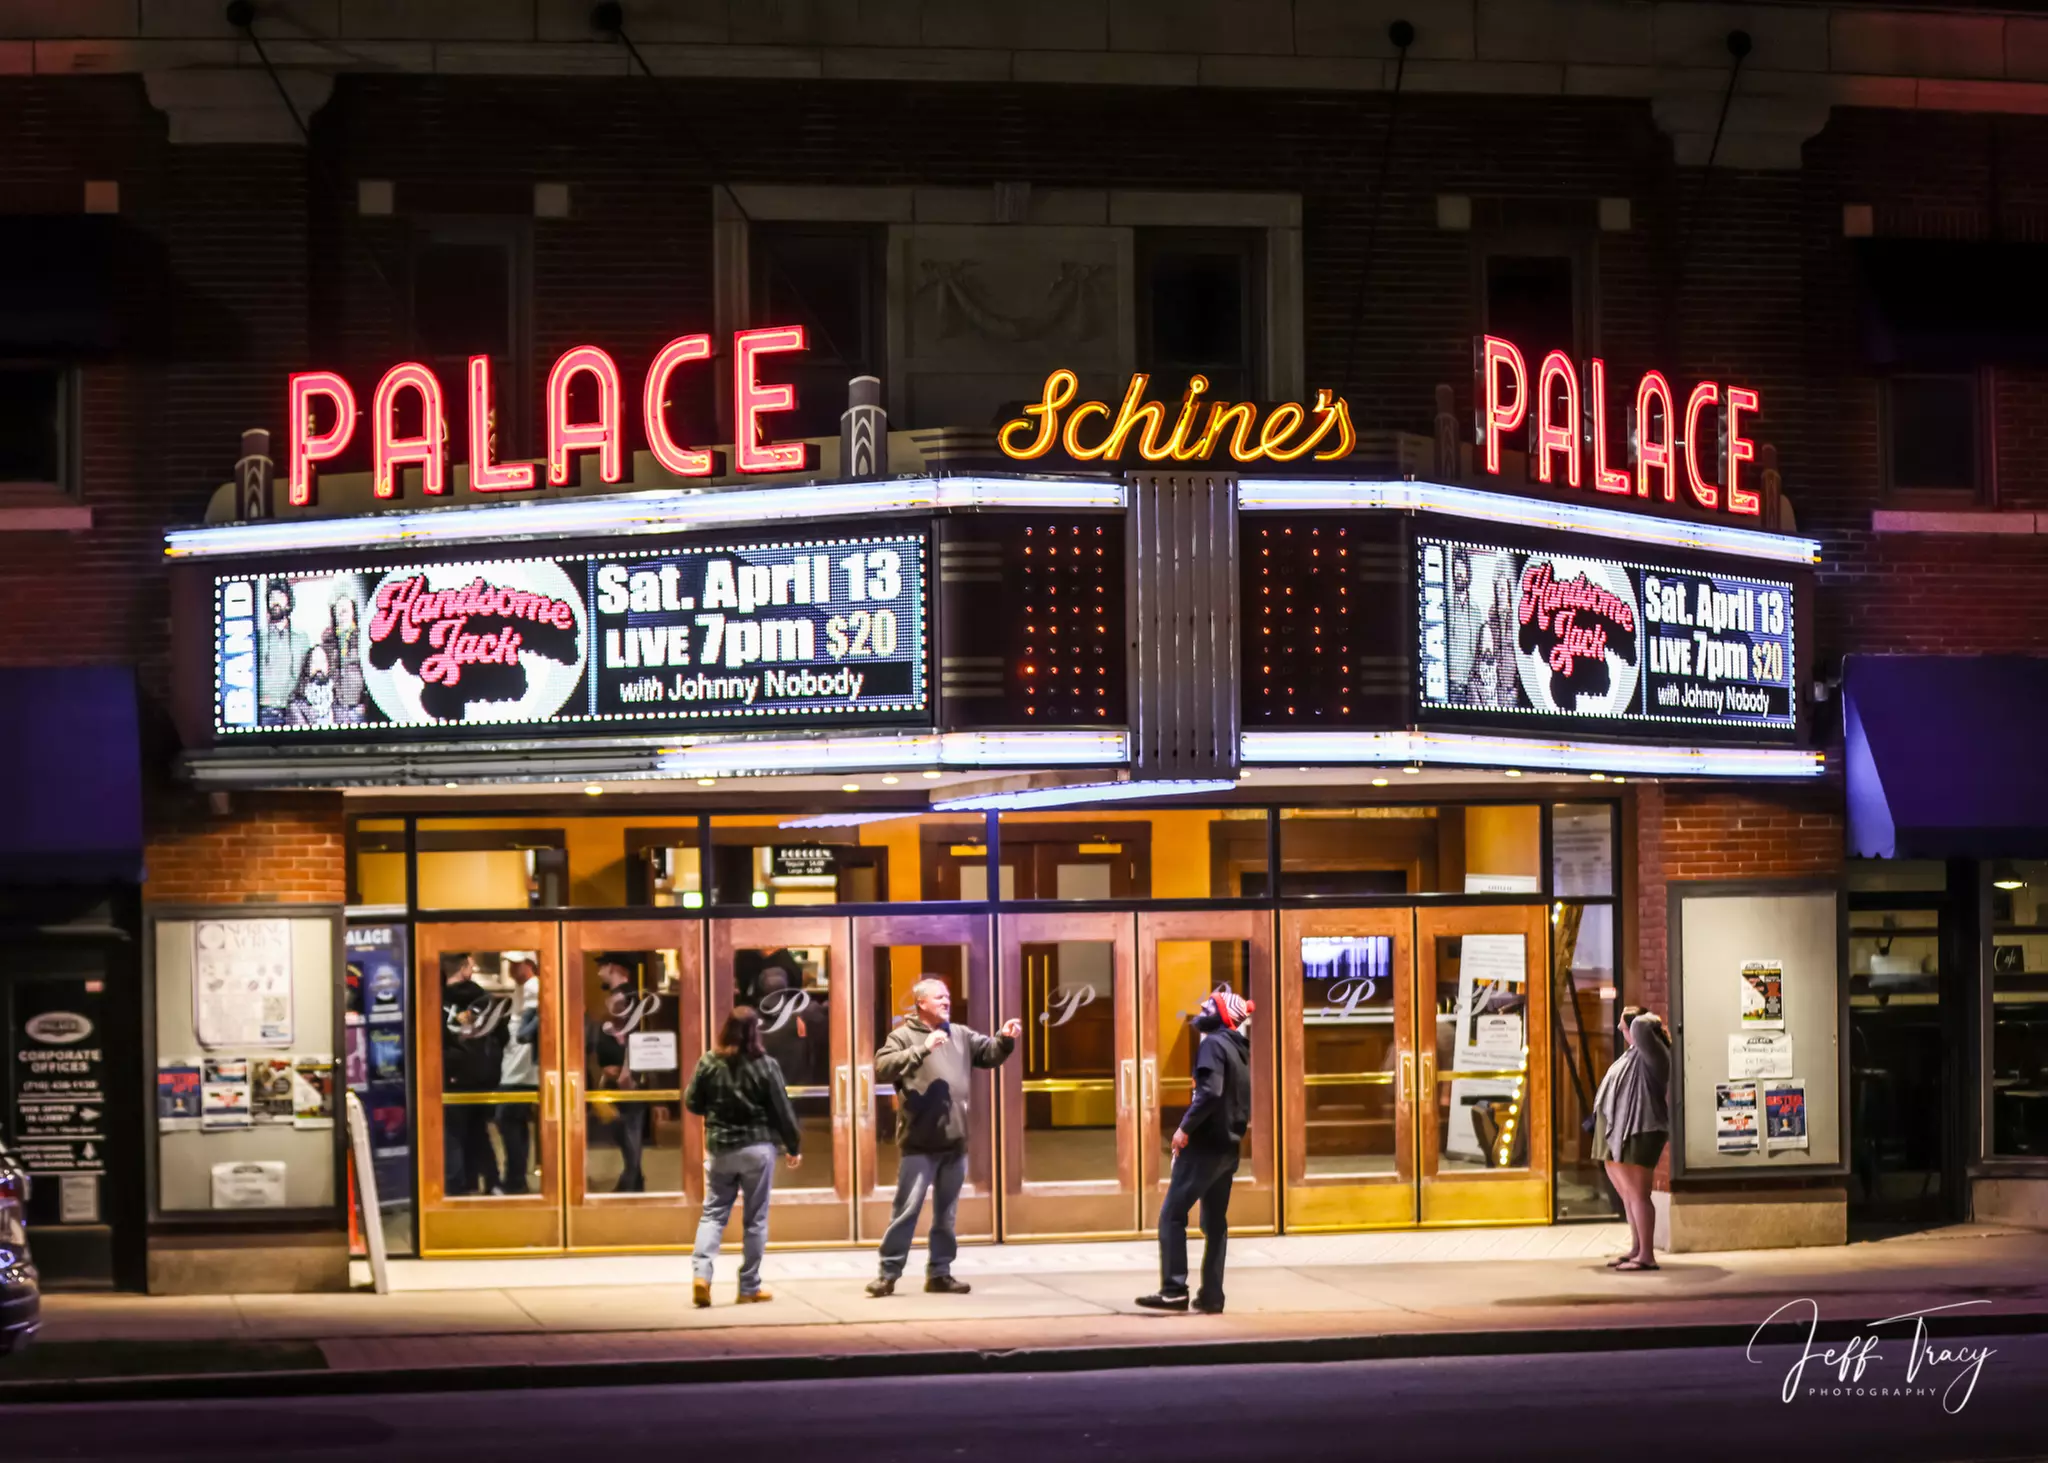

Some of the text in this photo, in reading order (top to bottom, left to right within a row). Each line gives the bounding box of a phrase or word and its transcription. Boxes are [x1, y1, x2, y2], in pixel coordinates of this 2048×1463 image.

[289, 325, 806, 506] PALACE
[997, 368, 1356, 462] Schine's
[1484, 334, 1761, 515] PALACE
[369, 573, 575, 643] Handsome
[597, 551, 901, 613] Sat. April 13
[1518, 561, 1634, 633] Handsome
[1645, 576, 1784, 636] Sat. April 13
[420, 615, 523, 686] Jack
[606, 609, 897, 668] LIVE 7pm $20
[1549, 609, 1606, 678] Jack
[1650, 631, 1783, 682] LIVE 7pm $20
[620, 668, 863, 704] with Johnny Nobody
[1657, 684, 1770, 717] with Johnny Nobody
[345, 928, 391, 945] ALACE
[602, 989, 661, 1035] P
[757, 988, 810, 1033] P
[1039, 983, 1096, 1027] P
[1320, 977, 1376, 1019] P
[18, 1049, 102, 1062] CORPORATE
[31, 1061, 89, 1073] OFFICES
